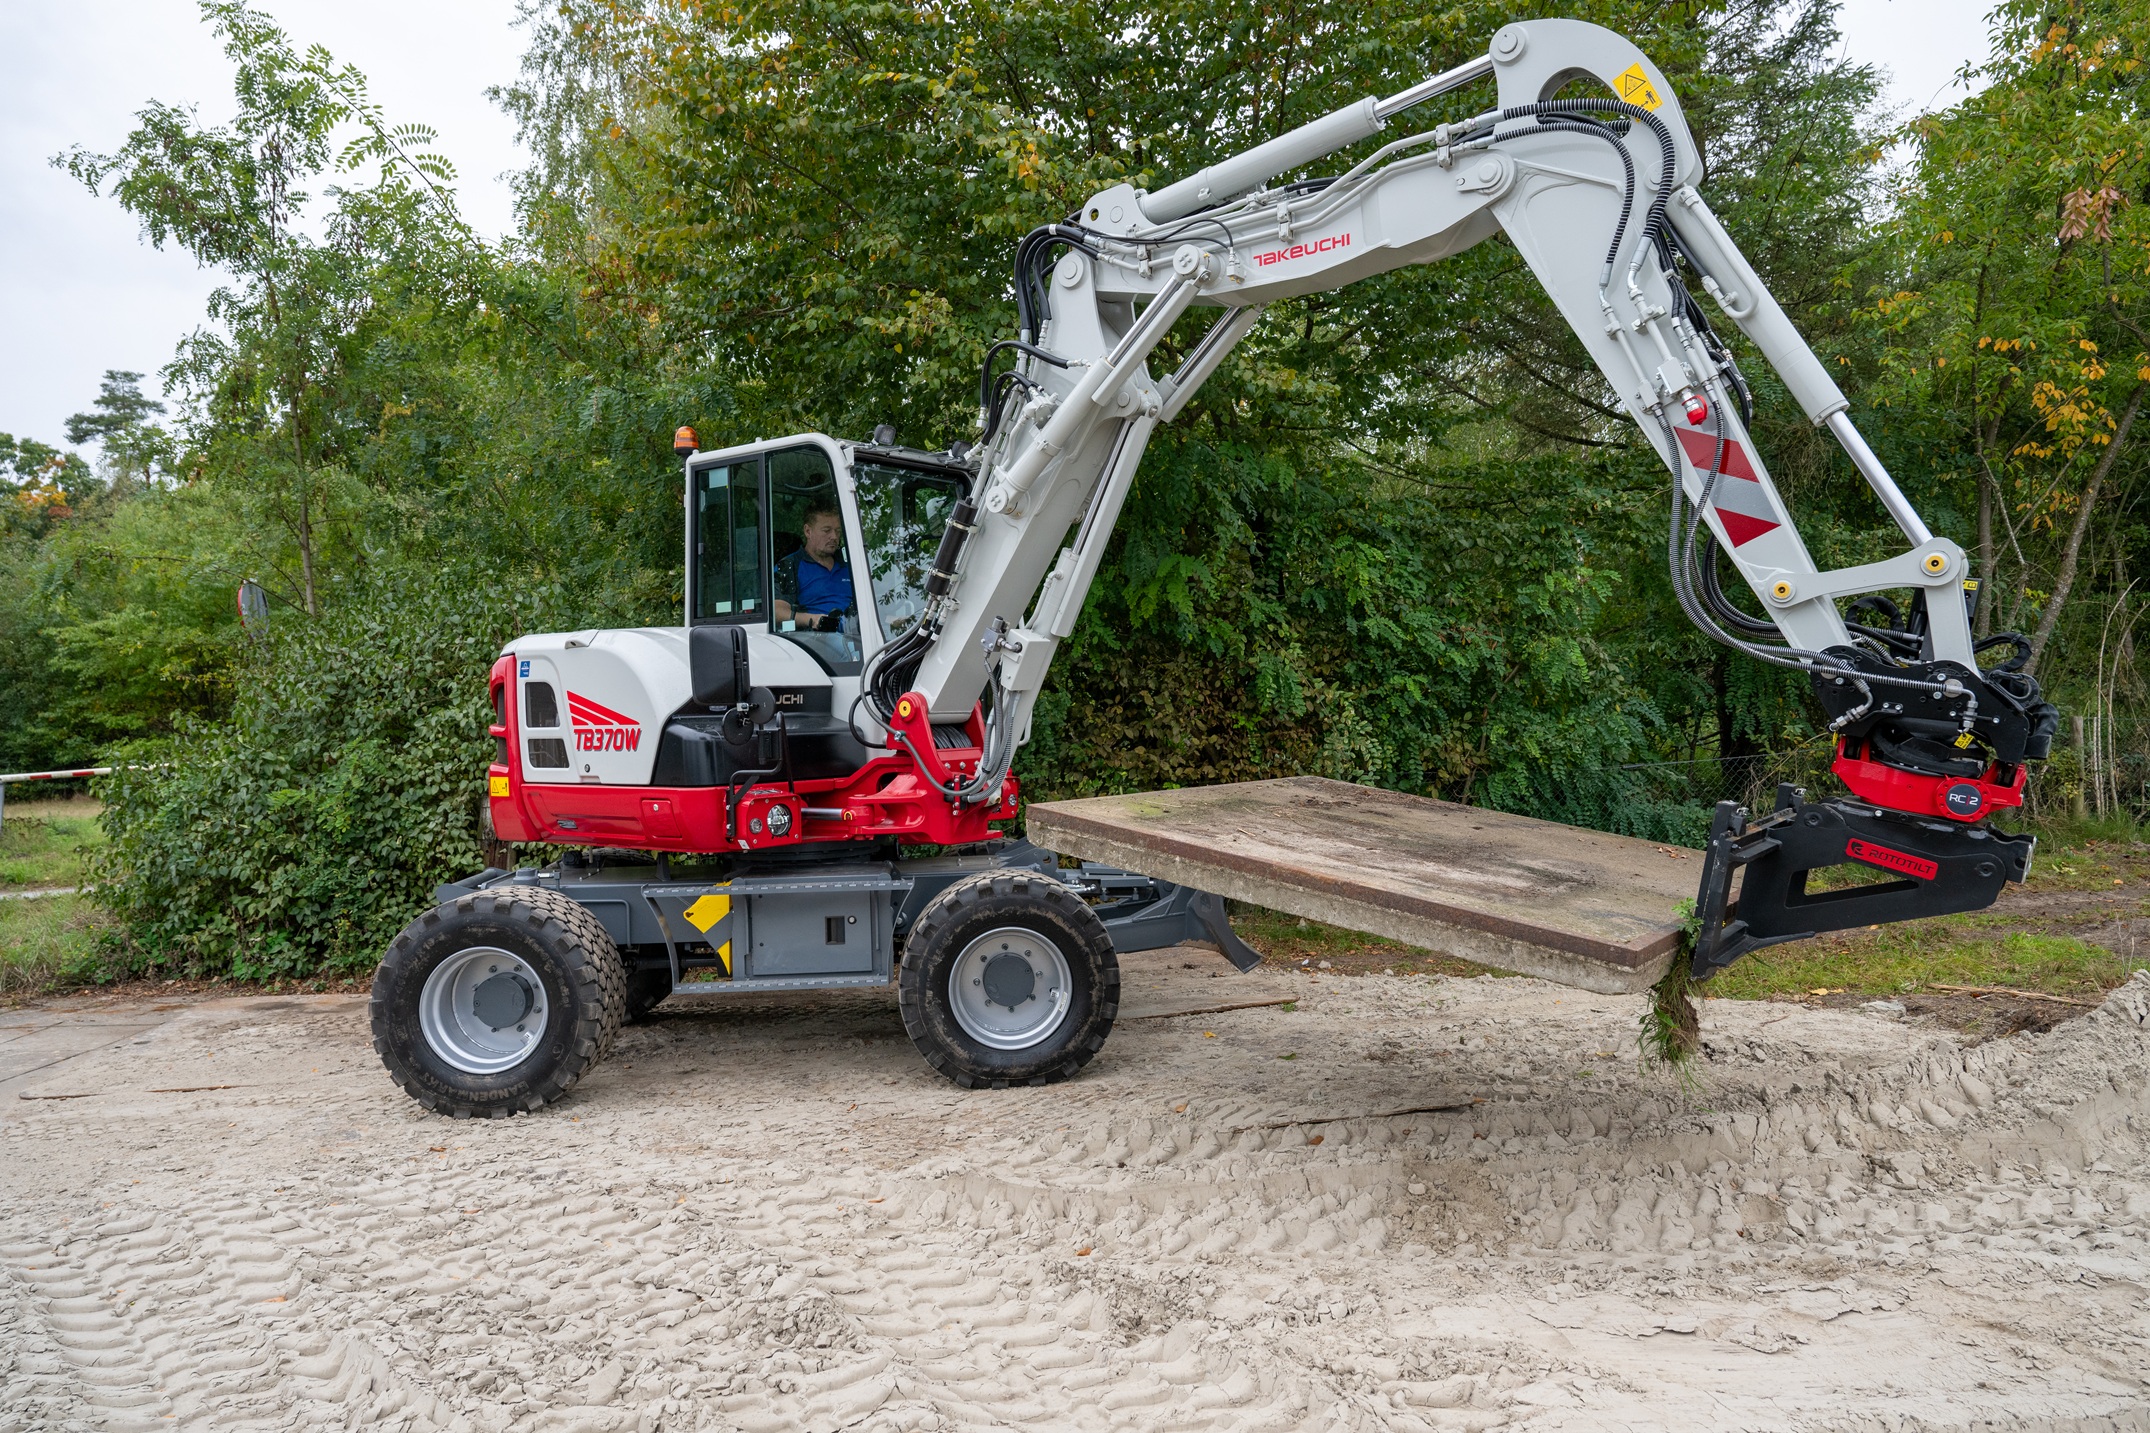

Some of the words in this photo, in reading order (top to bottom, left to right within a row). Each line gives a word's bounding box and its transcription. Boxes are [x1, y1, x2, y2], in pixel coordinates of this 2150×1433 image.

[775, 694, 804, 705] UCHI
[573, 728, 642, 752] TB370W
[1868, 849, 1934, 874] ROTOTILT
